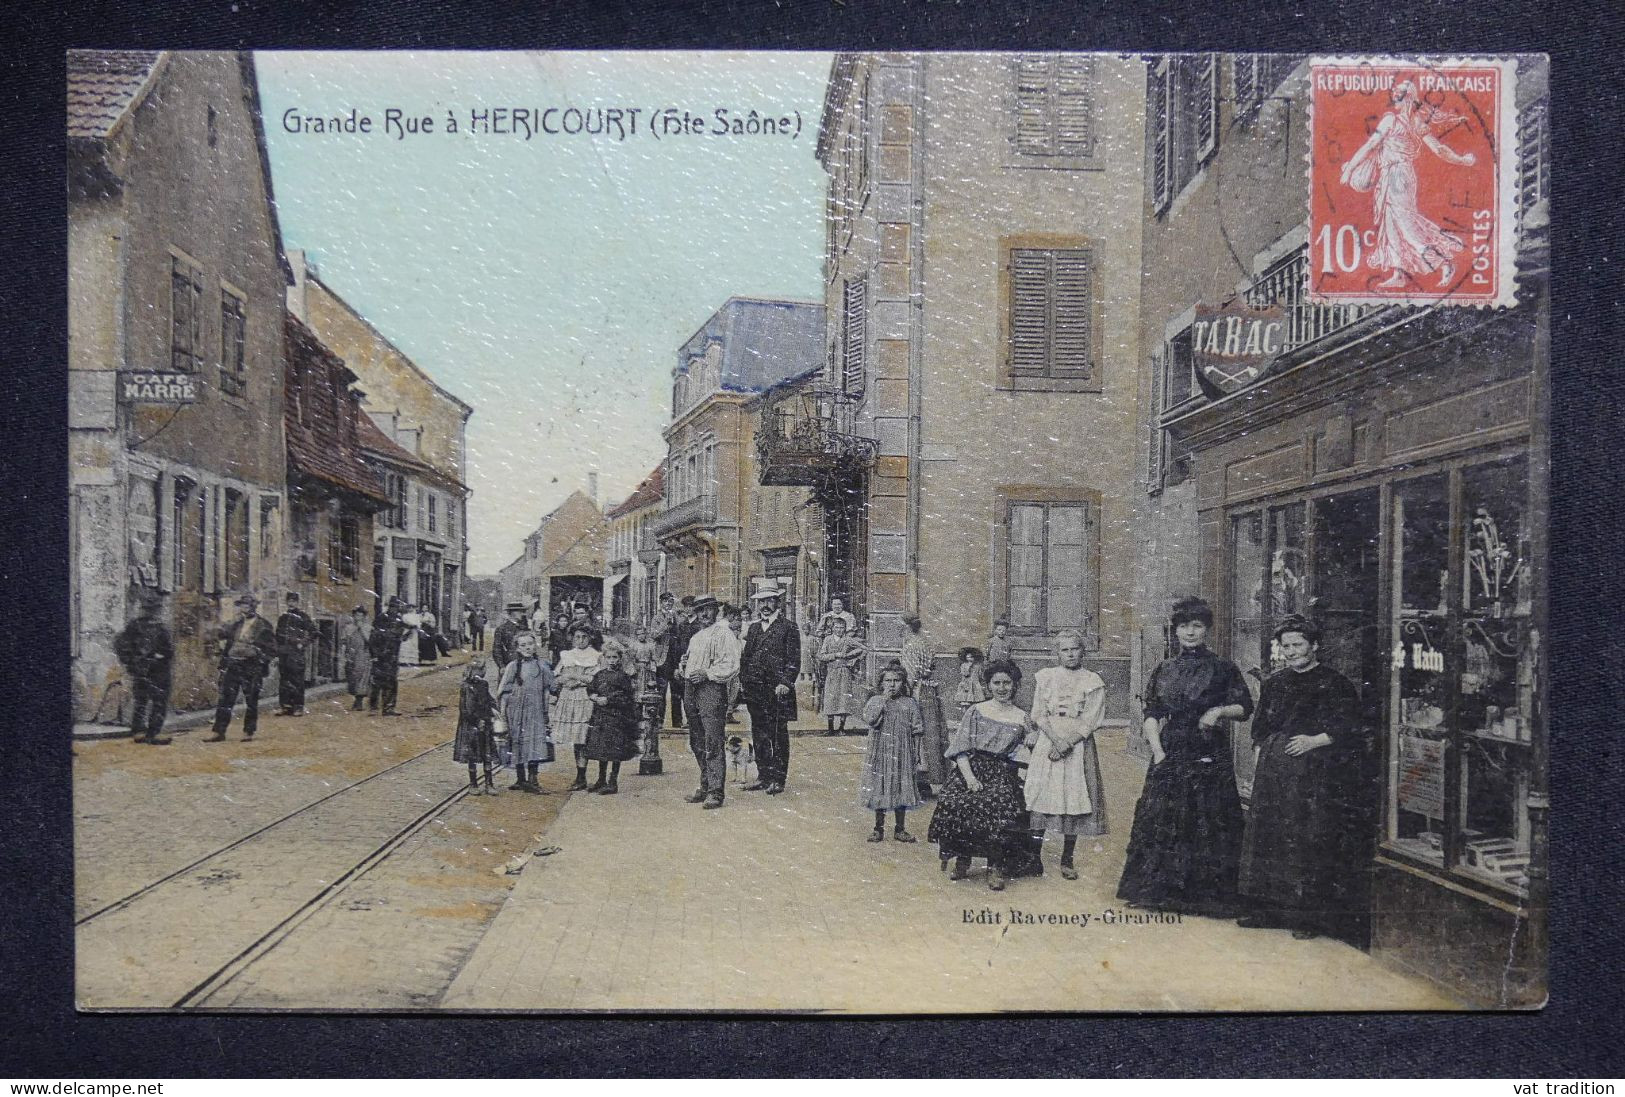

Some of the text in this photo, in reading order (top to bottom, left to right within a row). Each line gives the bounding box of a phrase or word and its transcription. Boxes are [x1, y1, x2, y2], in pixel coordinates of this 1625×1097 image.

[283, 107, 373, 134] Grande
[385, 108, 434, 140] Rue
[446, 110, 458, 134] à
[471, 107, 642, 141] HERICOURT
[711, 108, 802, 140] Saône)
[1472, 209, 1491, 285] POSTES
[1194, 315, 1281, 358] TABAC
